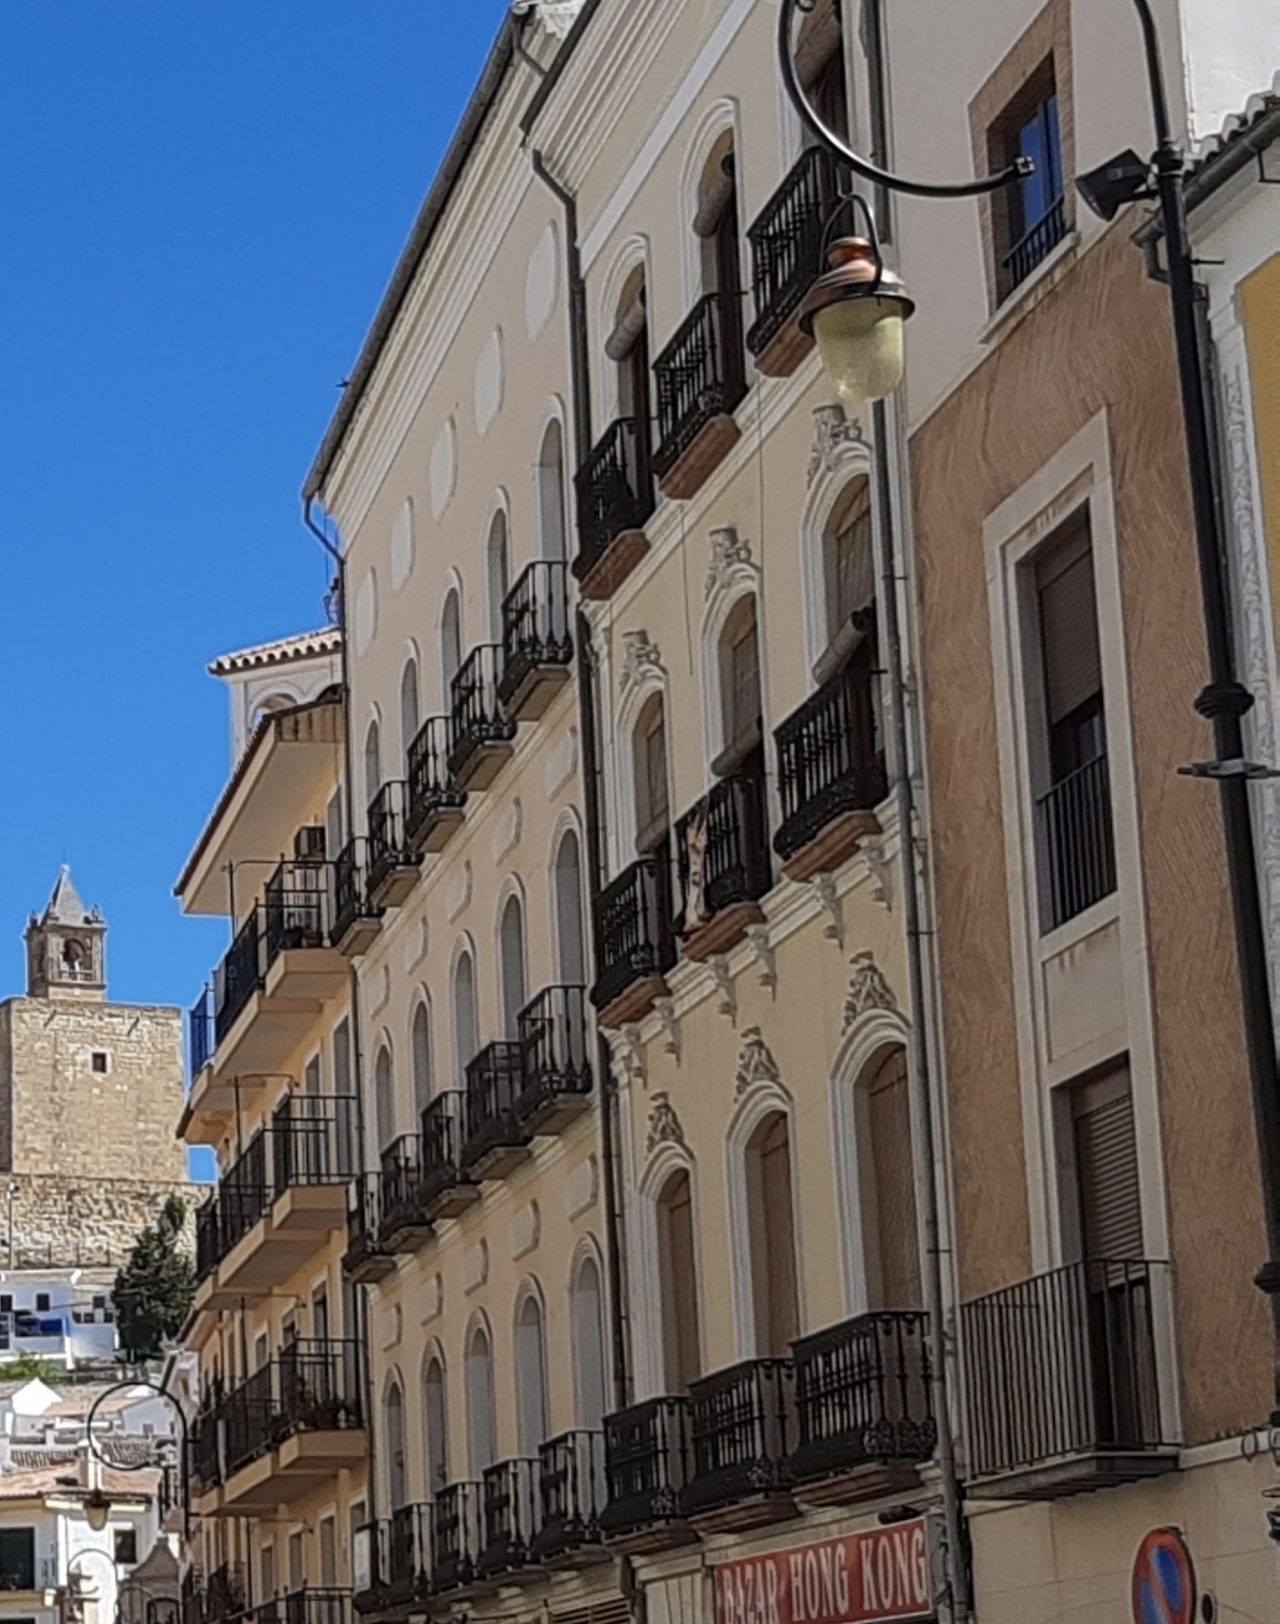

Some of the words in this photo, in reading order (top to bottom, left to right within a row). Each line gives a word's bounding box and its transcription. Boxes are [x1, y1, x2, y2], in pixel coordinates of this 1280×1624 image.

[723, 1559, 780, 1624] BAZAR
[790, 1543, 849, 1621] HONG
[860, 1527, 927, 1611] KONG
